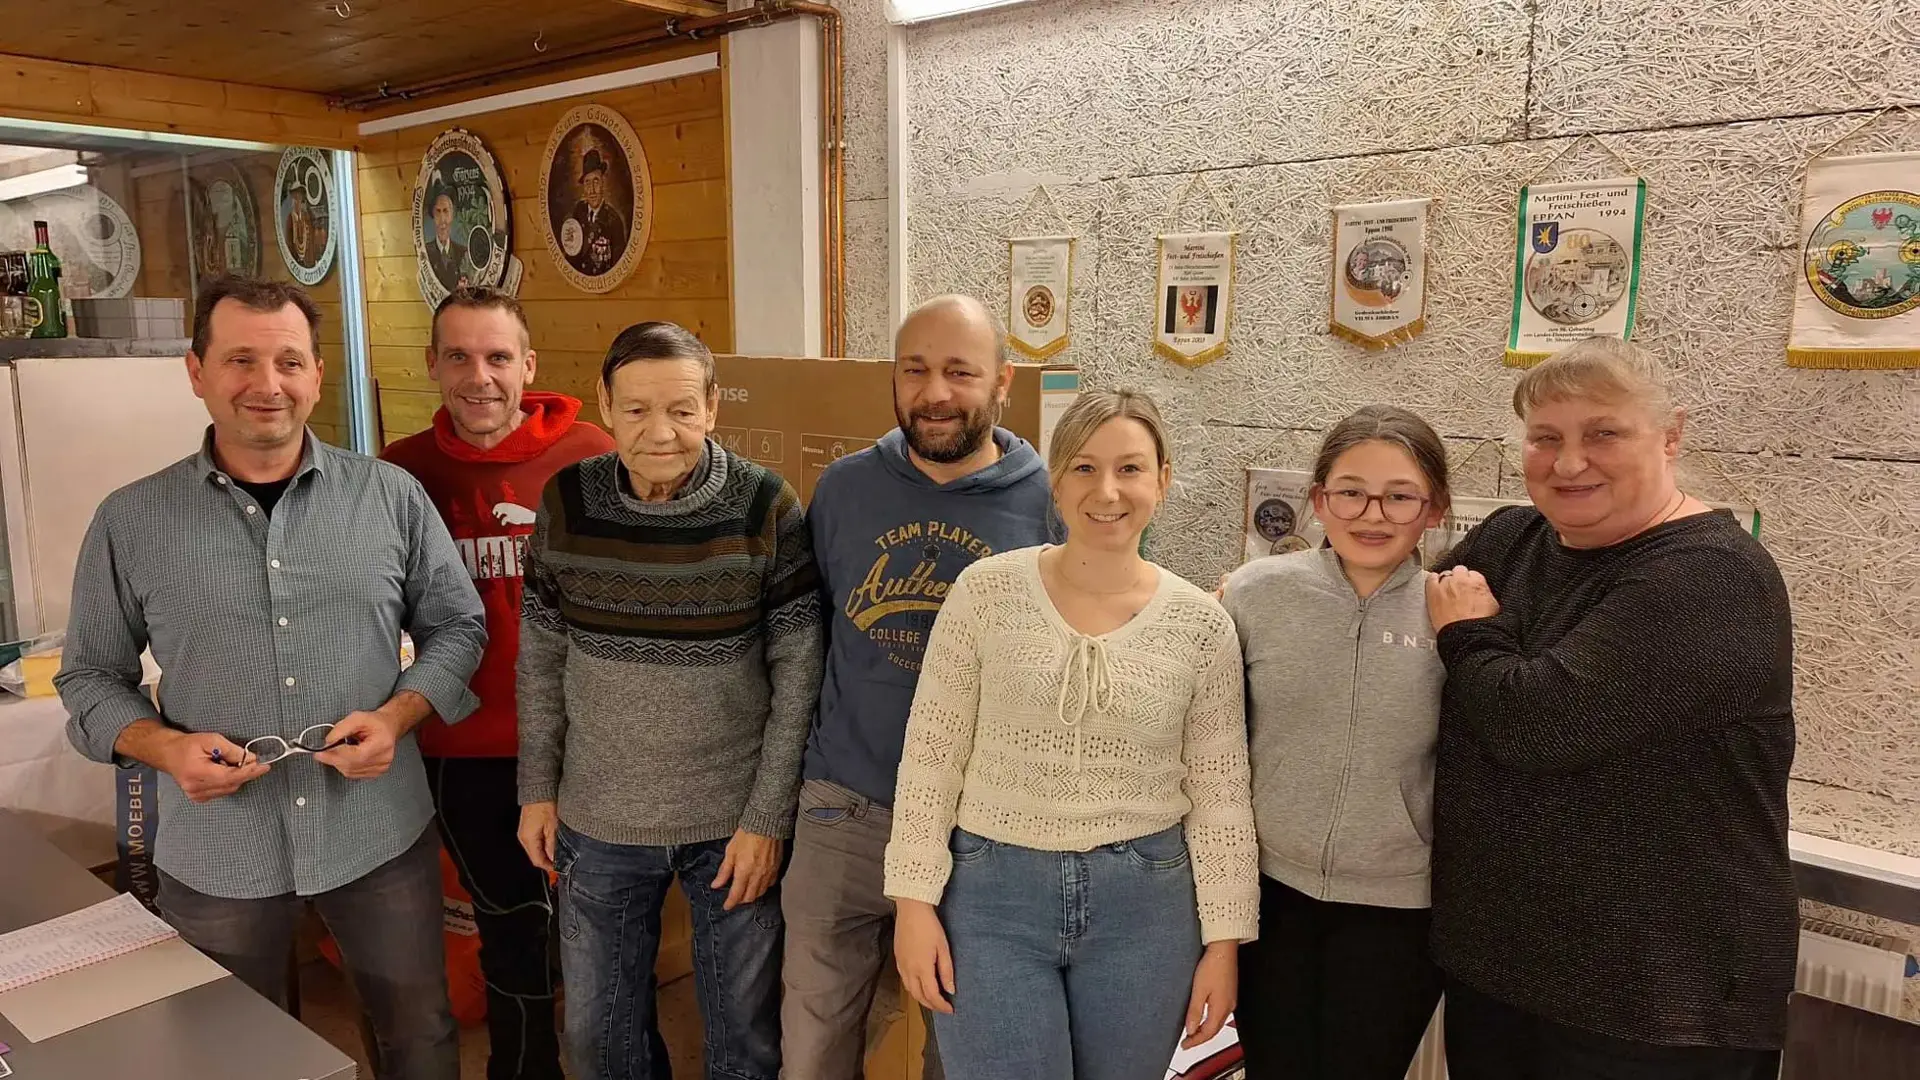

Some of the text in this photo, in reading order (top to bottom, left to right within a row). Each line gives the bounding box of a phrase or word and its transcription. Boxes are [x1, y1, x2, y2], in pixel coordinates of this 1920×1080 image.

[457, 186, 477, 200] 1994
[1534, 188, 1628, 203] Martini- Fest- und
[1548, 200, 1611, 210] Freischießen
[1532, 208, 1626, 221] EPPAN 1994
[874, 522, 921, 550] TEAM
[869, 627, 921, 644] COLLEGE
